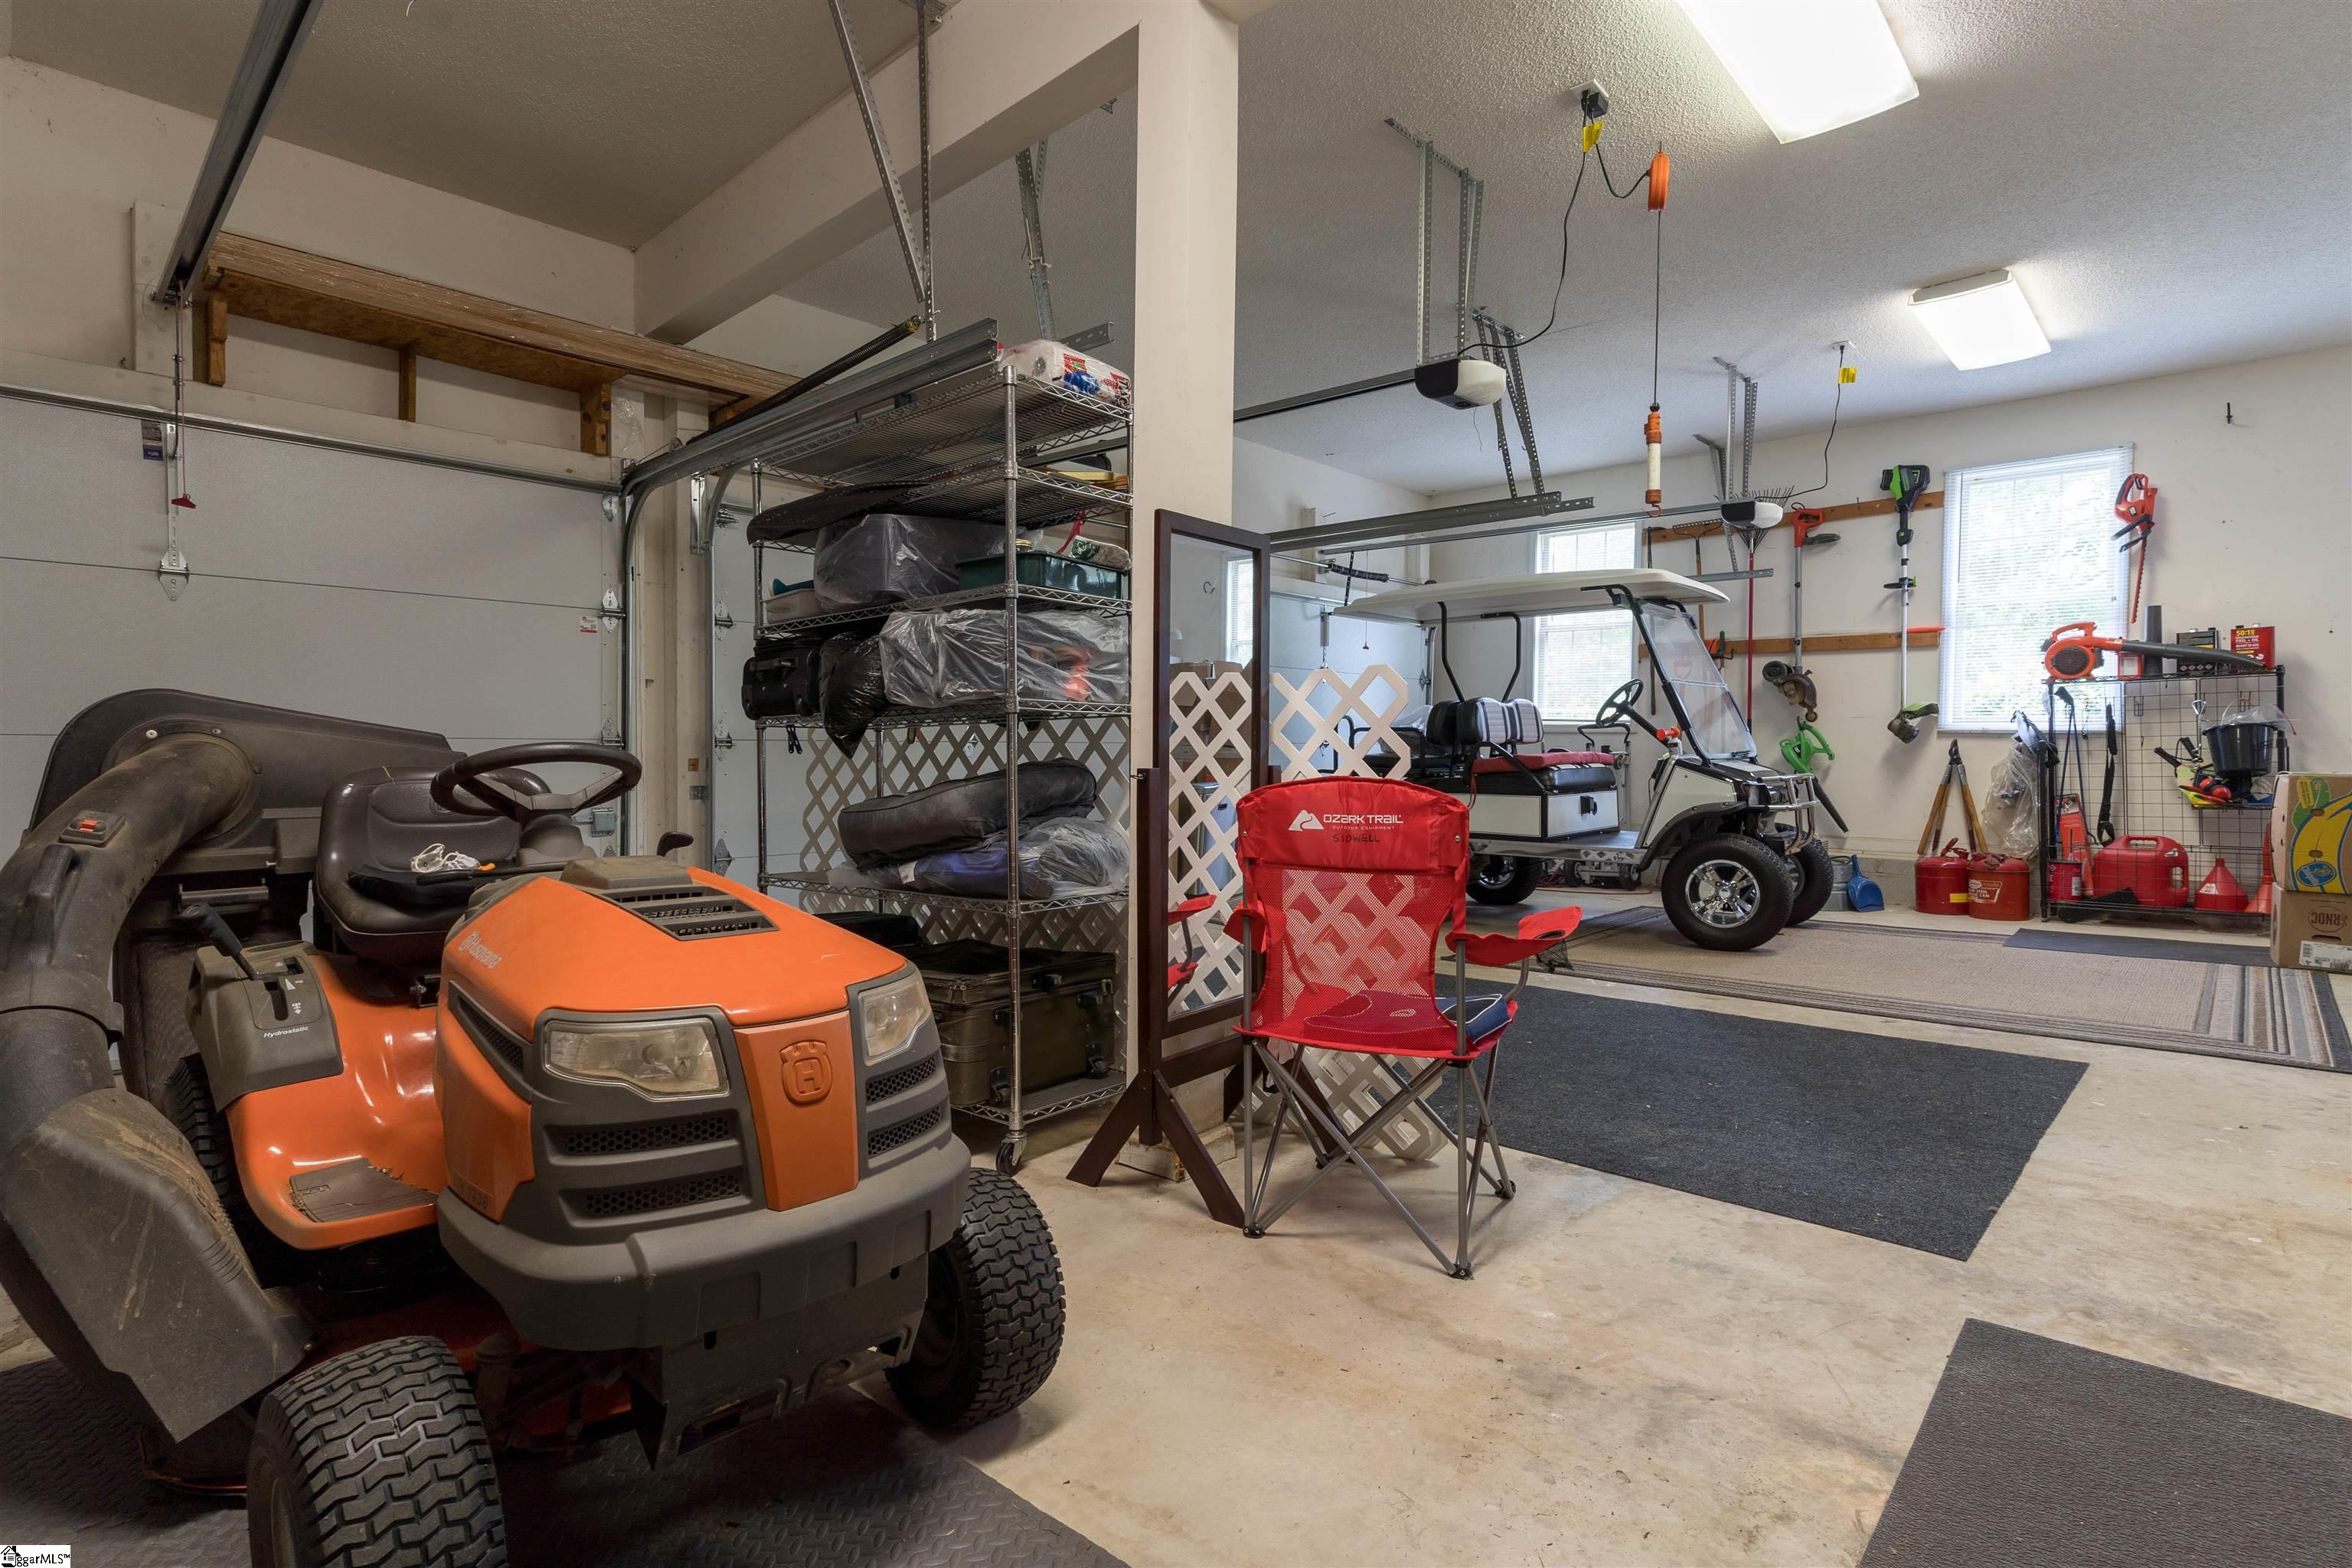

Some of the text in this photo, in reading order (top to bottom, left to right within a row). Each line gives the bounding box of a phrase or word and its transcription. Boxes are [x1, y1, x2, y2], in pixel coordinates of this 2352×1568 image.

[1323, 814, 1365, 824] OZARK
[1333, 833, 1380, 842] SIDWELL
[263, 1026, 309, 1038] Hydrostatic
